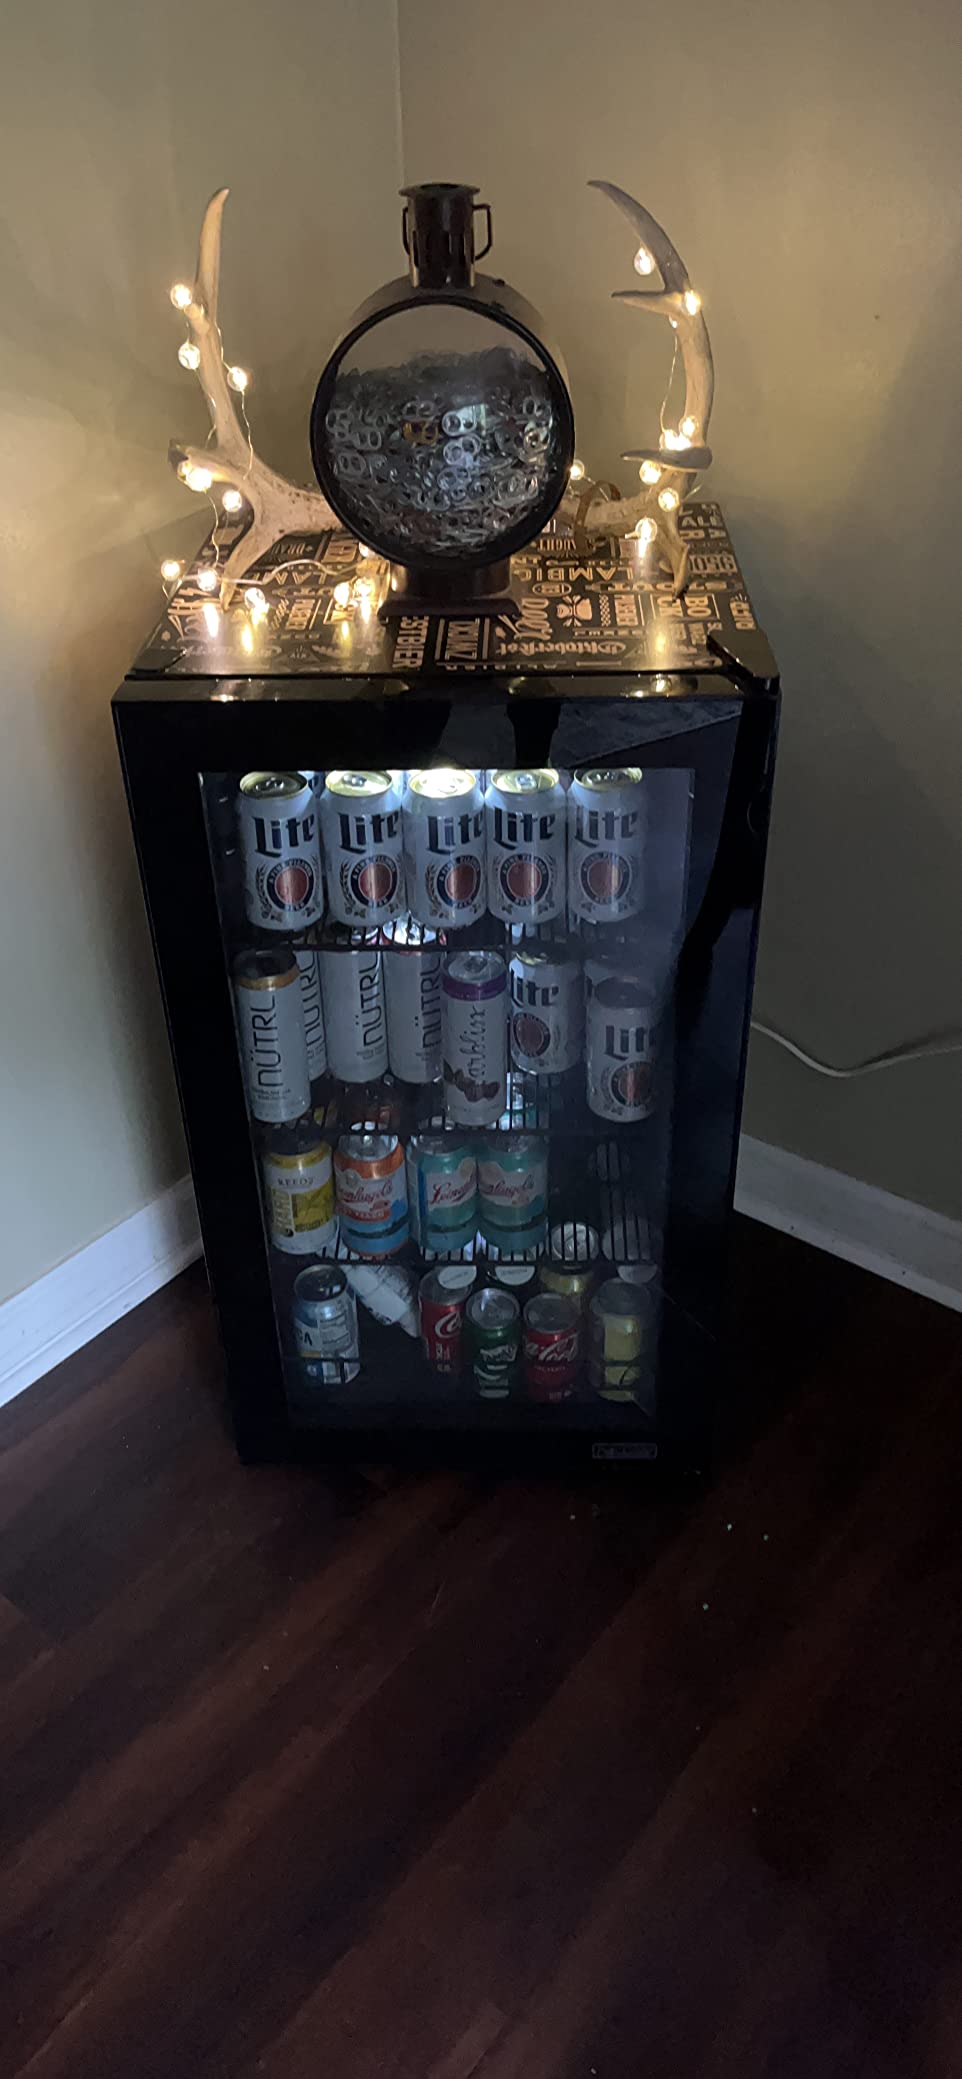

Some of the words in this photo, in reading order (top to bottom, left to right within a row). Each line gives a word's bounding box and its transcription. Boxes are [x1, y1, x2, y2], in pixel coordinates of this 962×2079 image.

[513, 567, 634, 582] LAMBIC
[395, 615, 429, 670] ESTBIER
[252, 814, 315, 858] Lite
[337, 811, 400, 855] Lite
[422, 810, 484, 855] Lite
[493, 806, 556, 851] Lite
[573, 805, 639, 849] Lite
[355, 951, 384, 1047] NÜTRL
[511, 968, 559, 1008] Lite
[250, 995, 284, 1088] NÜTRL
